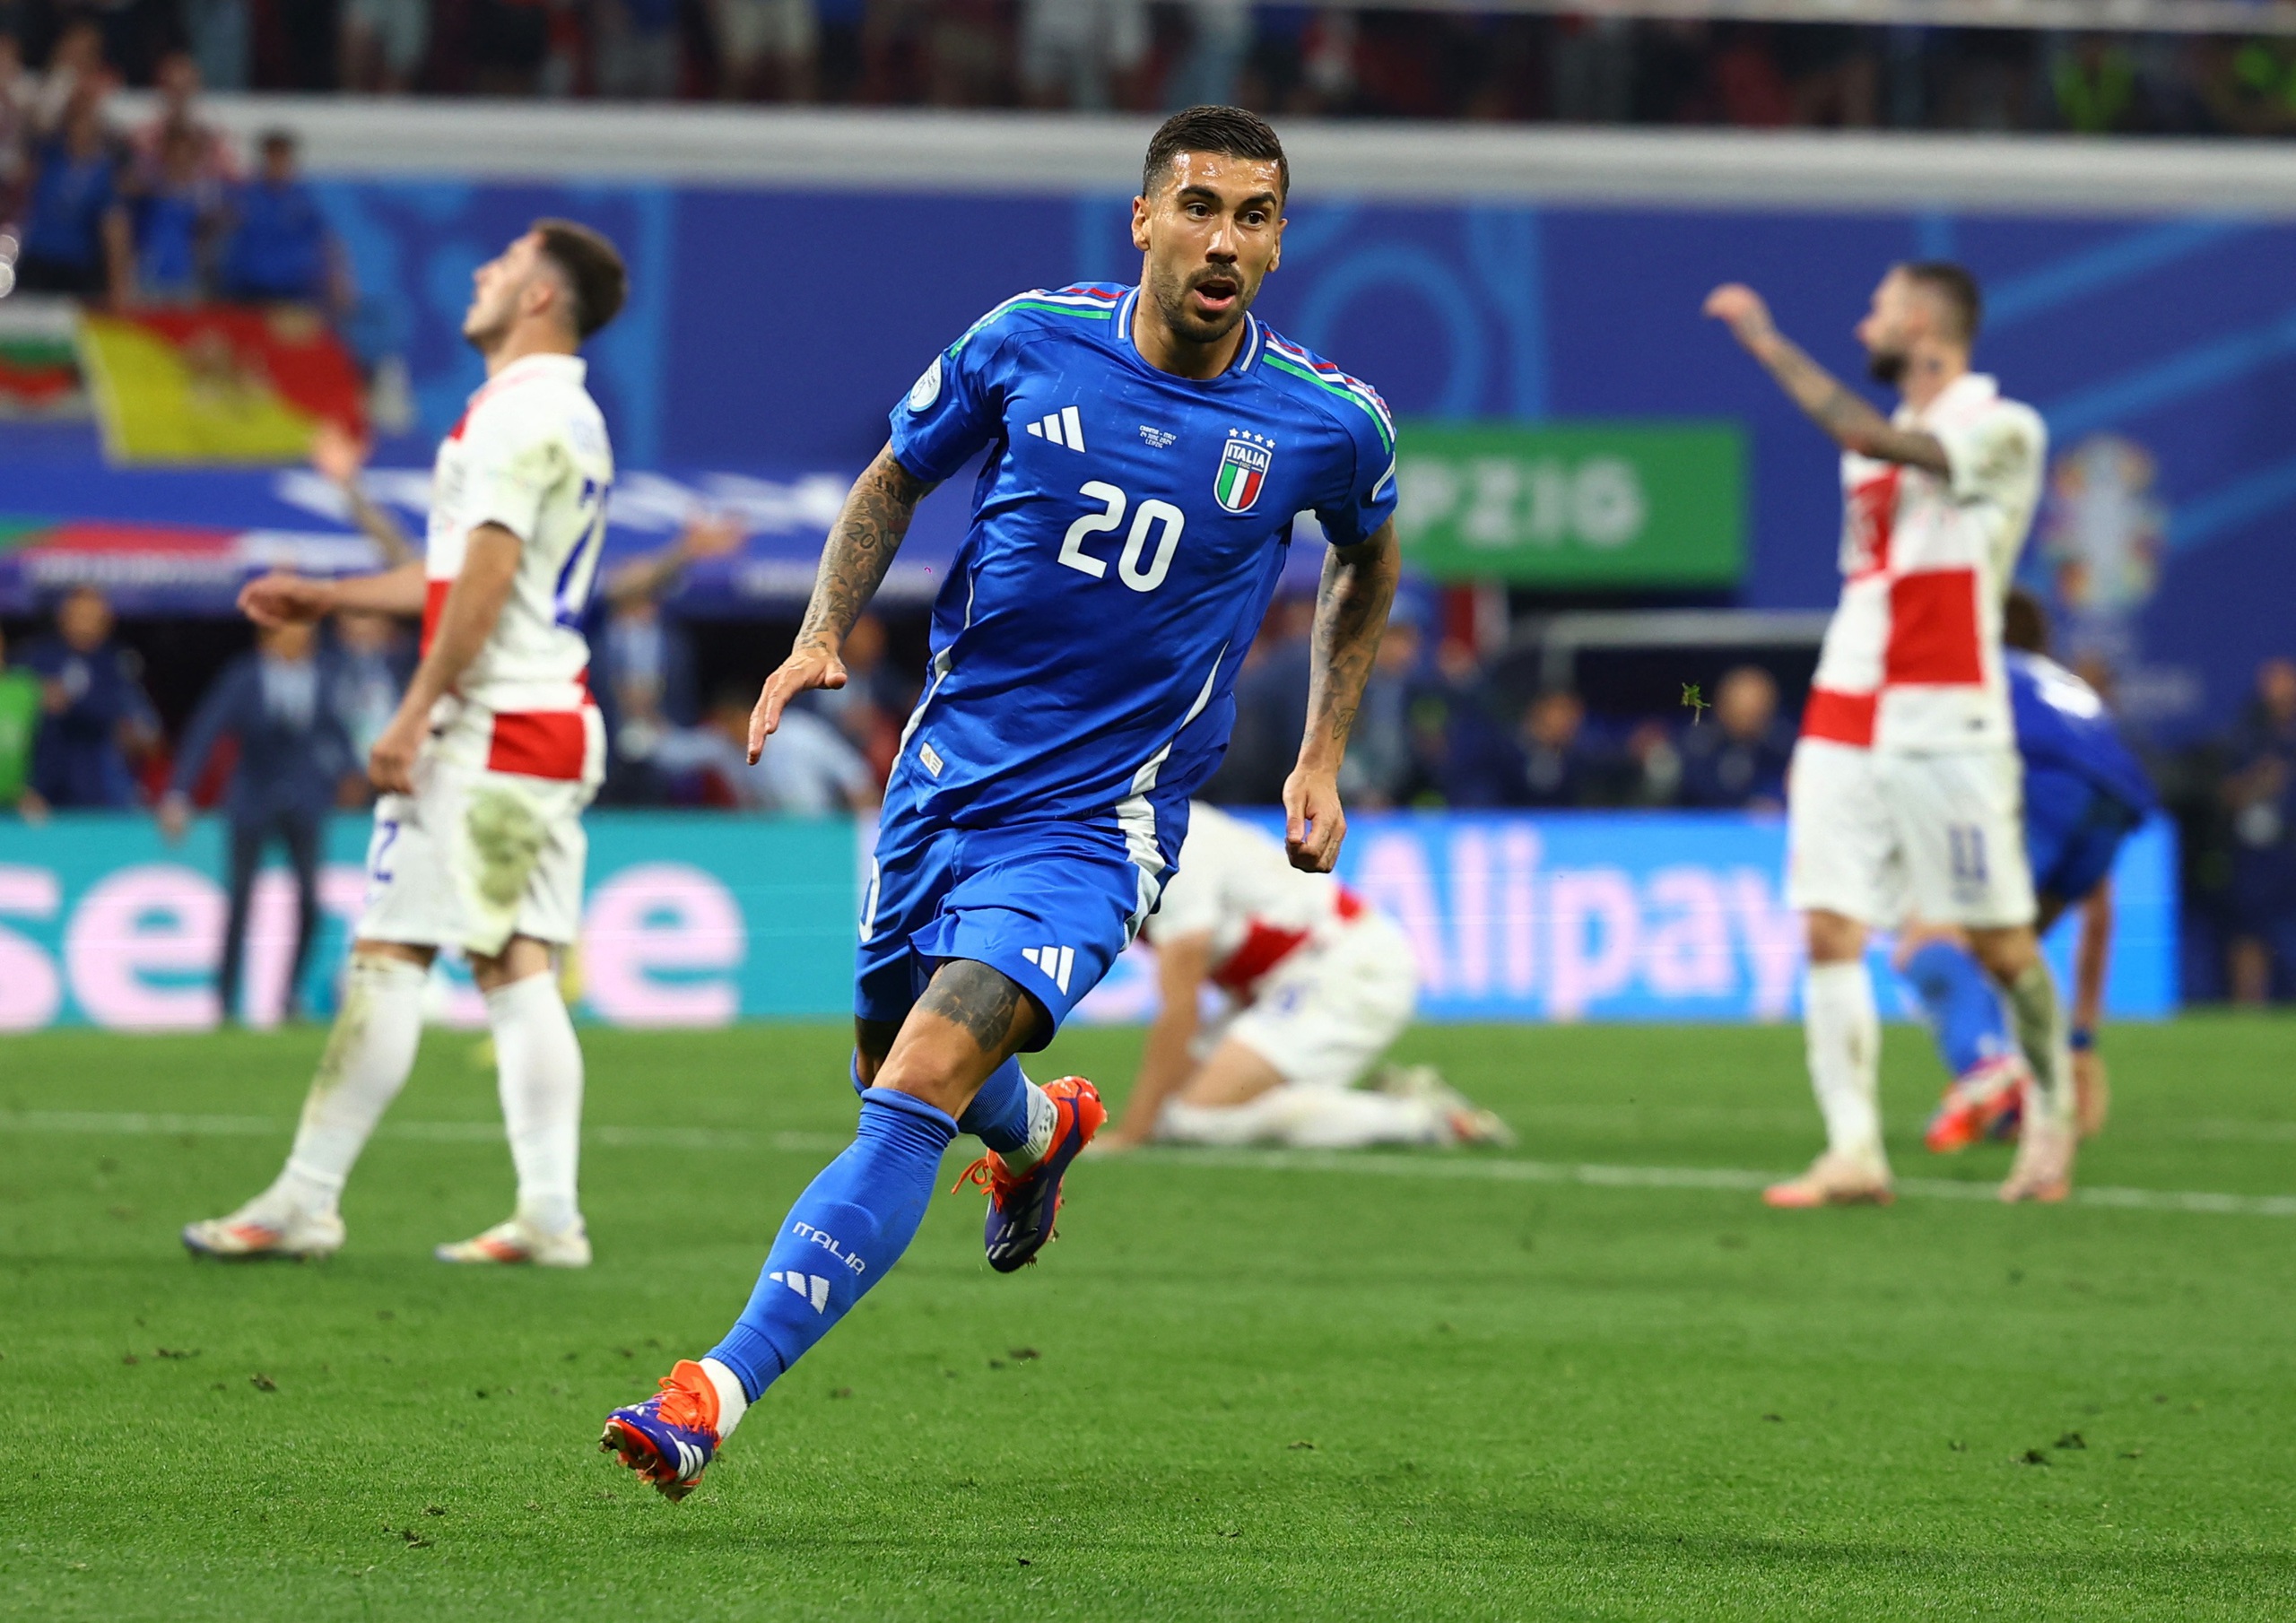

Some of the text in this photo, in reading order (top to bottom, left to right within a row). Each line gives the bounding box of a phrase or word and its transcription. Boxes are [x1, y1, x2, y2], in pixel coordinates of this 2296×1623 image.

[1227, 444, 1265, 468] ITALIA
[842, 520, 875, 550] 20
[1057, 480, 1185, 593] 20
[0, 859, 744, 1029] ene
[1354, 820, 1803, 1022] Alipay
[792, 1220, 866, 1276] ITALIA
